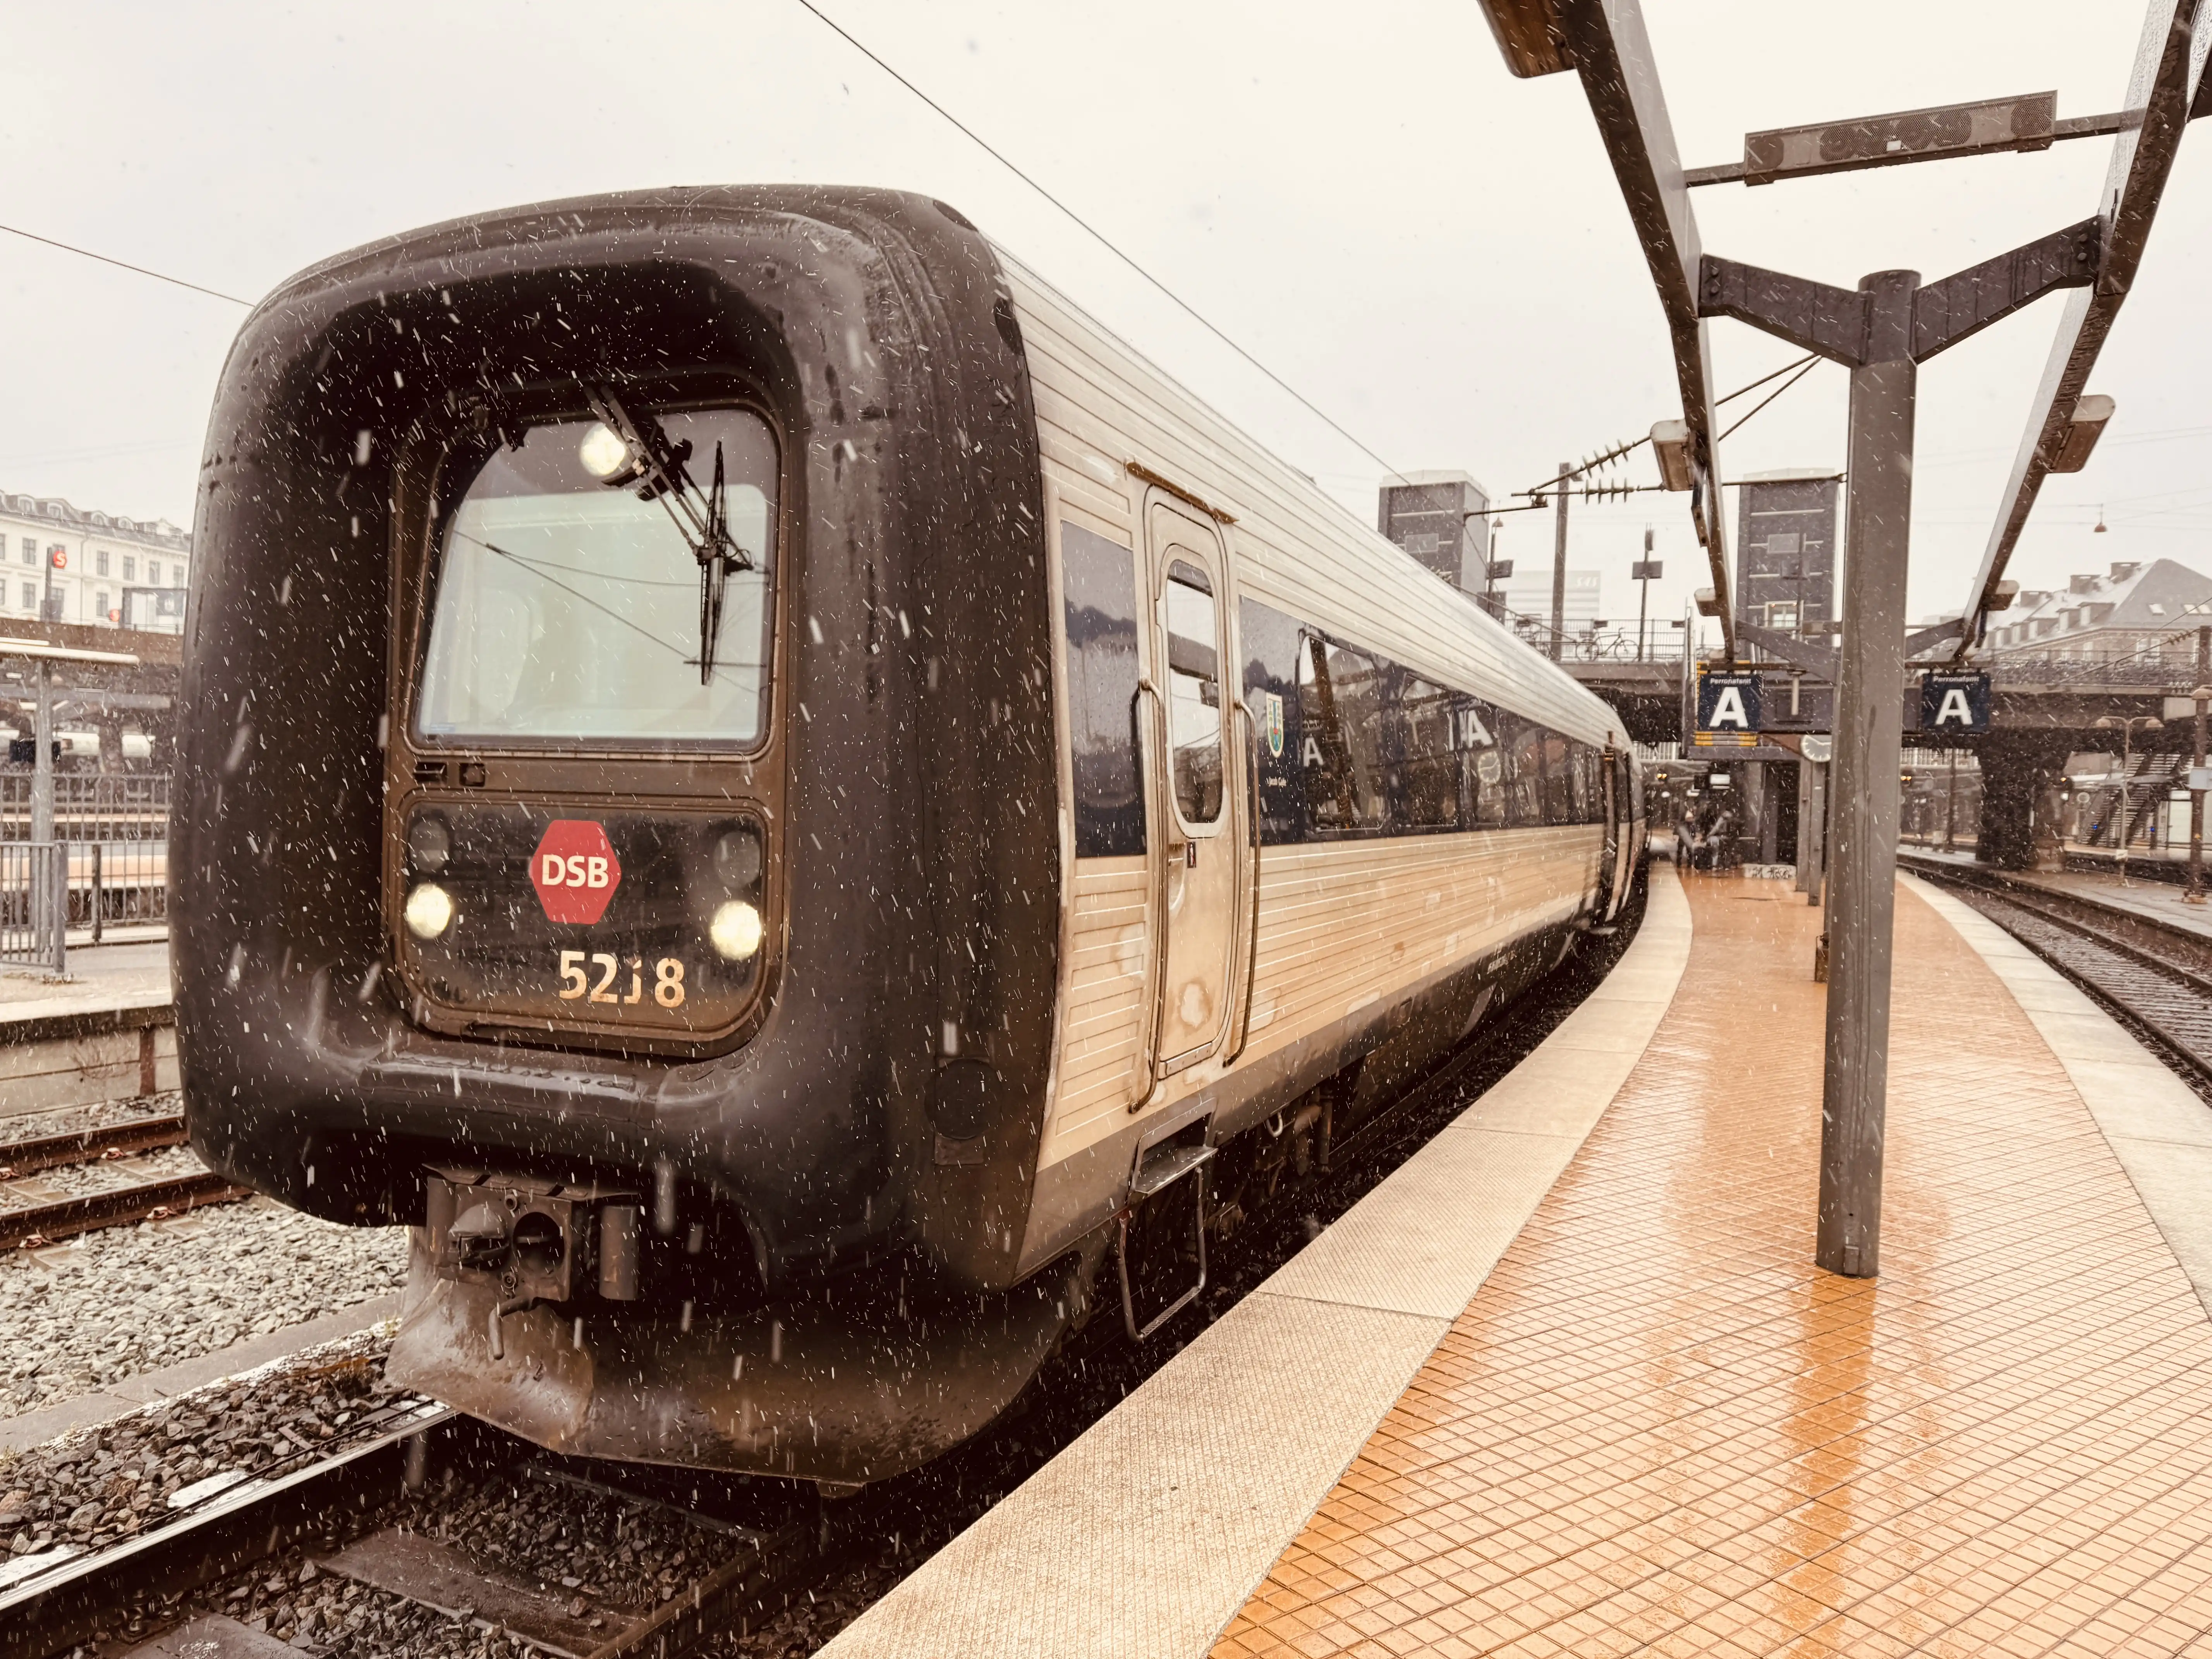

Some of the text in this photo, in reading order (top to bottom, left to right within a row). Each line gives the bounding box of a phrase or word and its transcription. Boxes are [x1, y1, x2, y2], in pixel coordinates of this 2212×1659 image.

[57, 552, 66, 567] S
[1709, 686, 1749, 728] A
[1935, 689, 1973, 725] A
[542, 854, 609, 888] DSB
